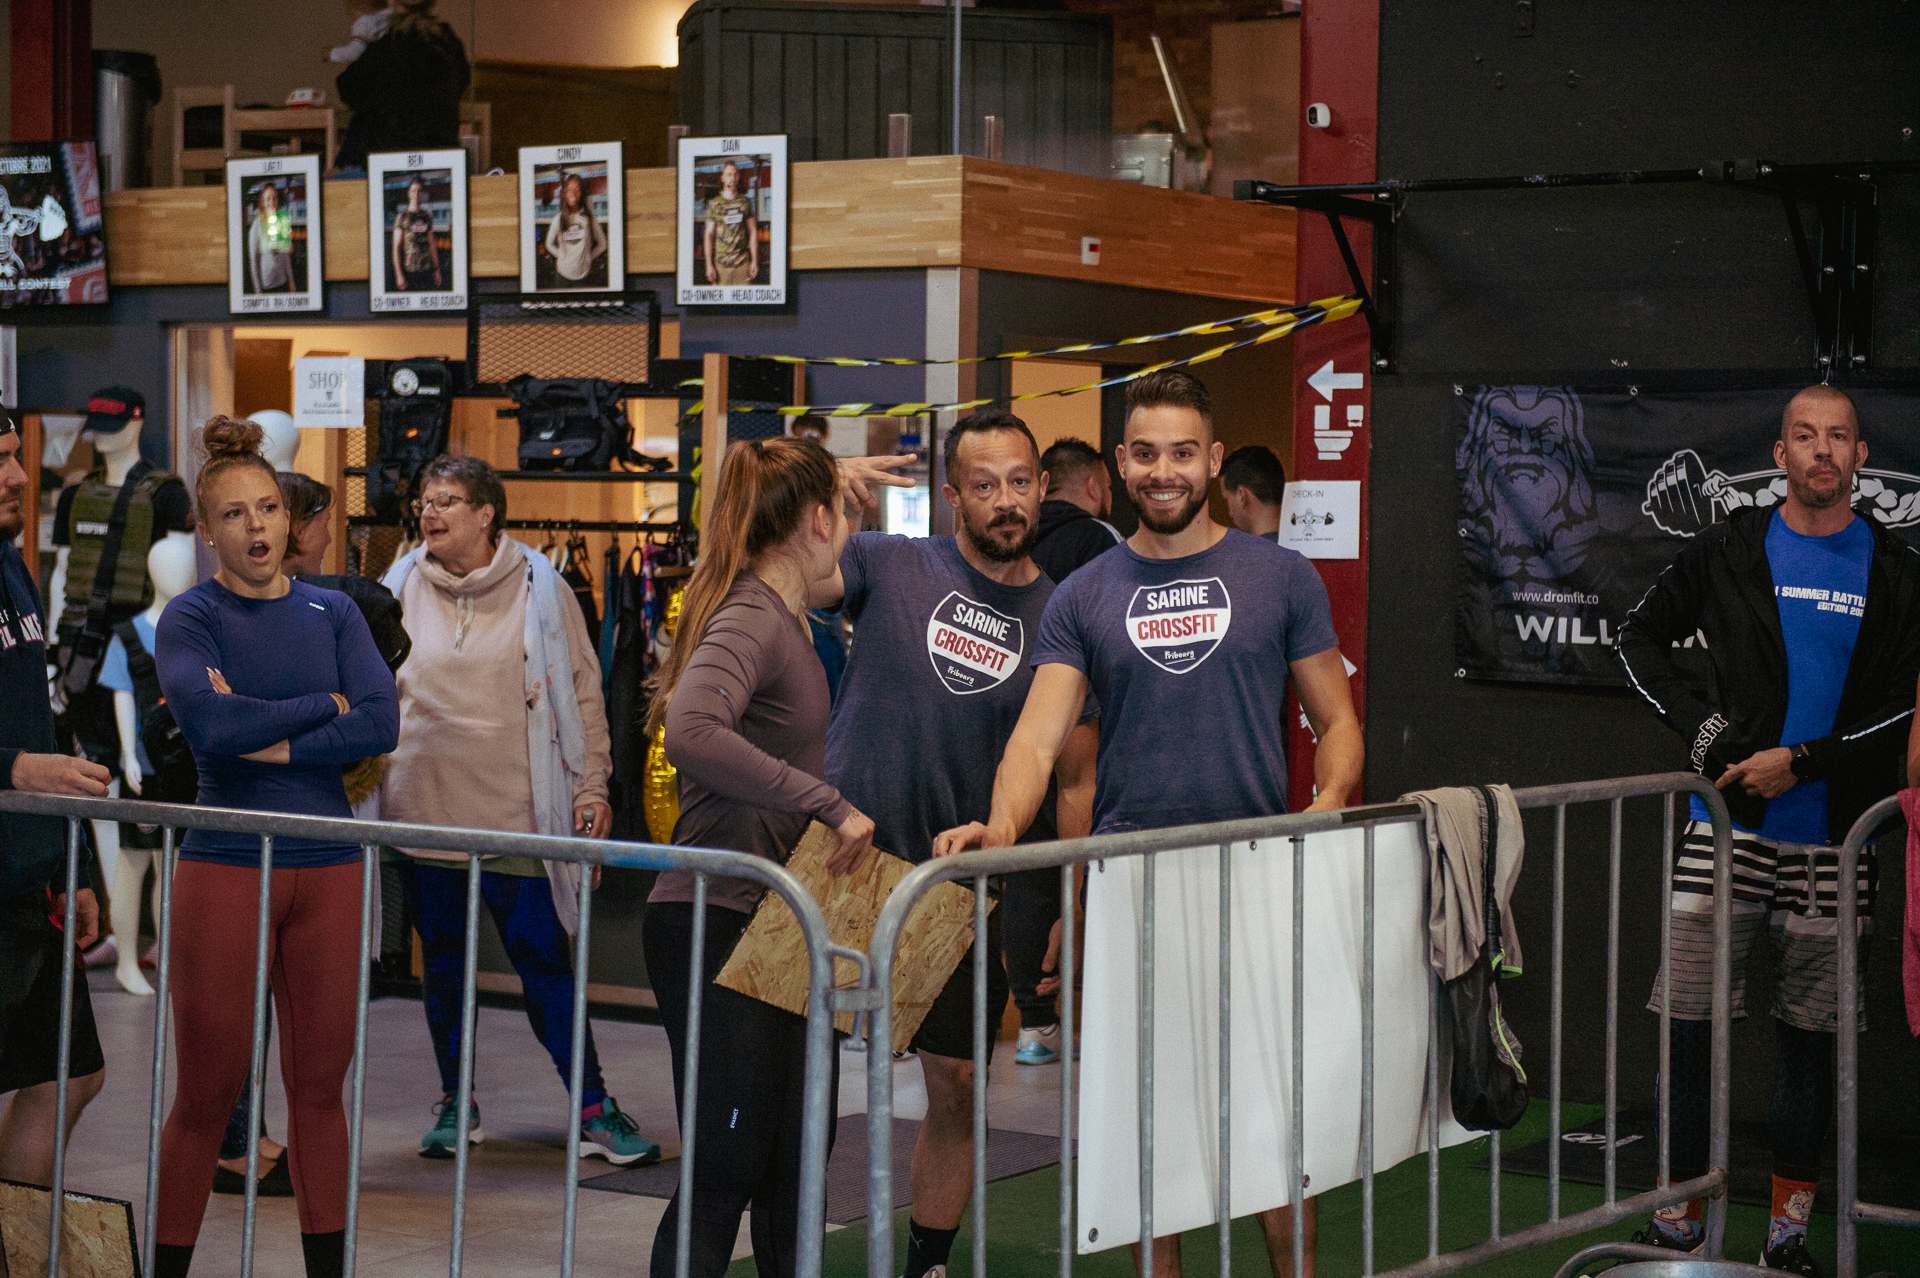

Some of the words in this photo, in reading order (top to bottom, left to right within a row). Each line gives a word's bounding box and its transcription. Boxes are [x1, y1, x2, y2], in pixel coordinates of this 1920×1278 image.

[557, 147, 583, 161] CINDY
[722, 139, 741, 152] DAN
[30, 155, 52, 174] 2021
[18, 278, 72, 290] CONTEST
[682, 289, 724, 302] CO-OWNER
[732, 289, 754, 301] HEAD
[755, 288, 782, 301] COACH
[308, 371, 347, 390] SHOP
[1146, 586, 1209, 611] SARINE
[1781, 586, 1831, 601] SUMMER
[1817, 601, 1849, 614] EDITION
[952, 603, 1011, 642] SARINE
[1137, 613, 1219, 641] CROSSFIT
[934, 627, 1010, 672] CROSSFIT
[1164, 649, 1195, 662] Fribourg
[947, 665, 975, 685] Fribourg
[1690, 713, 1729, 775] rossFit
